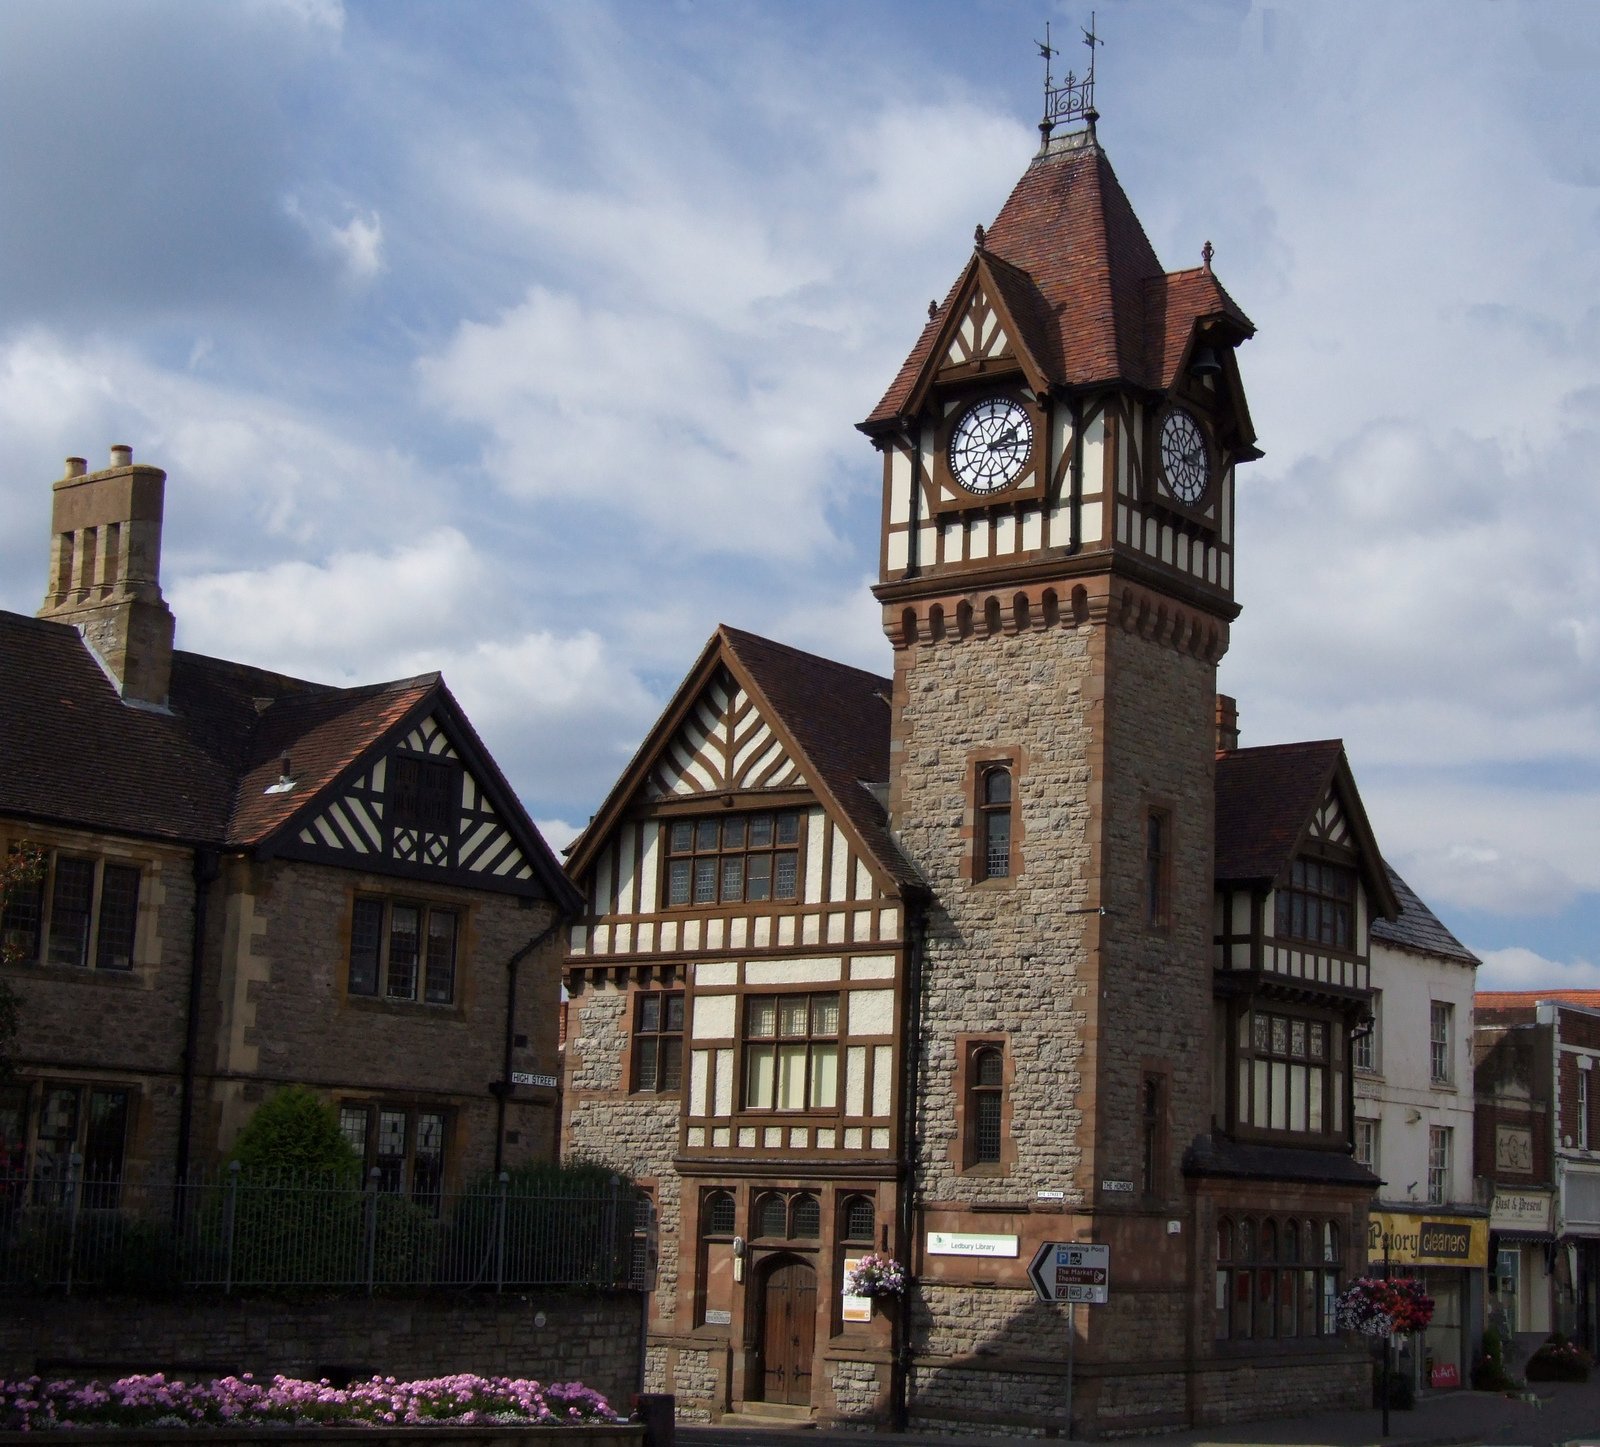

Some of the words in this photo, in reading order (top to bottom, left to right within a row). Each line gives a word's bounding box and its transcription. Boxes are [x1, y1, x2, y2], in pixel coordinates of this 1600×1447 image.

[513, 1074, 528, 1083] HIGH
[532, 1075, 555, 1086] STREET
[1104, 1181, 1113, 1189] THE
[1423, 1228, 1467, 1252] cleaners
[951, 1242, 974, 1251] Ledbury
[975, 1244, 996, 1252] Library
[1057, 1244, 1089, 1252] Swimming
